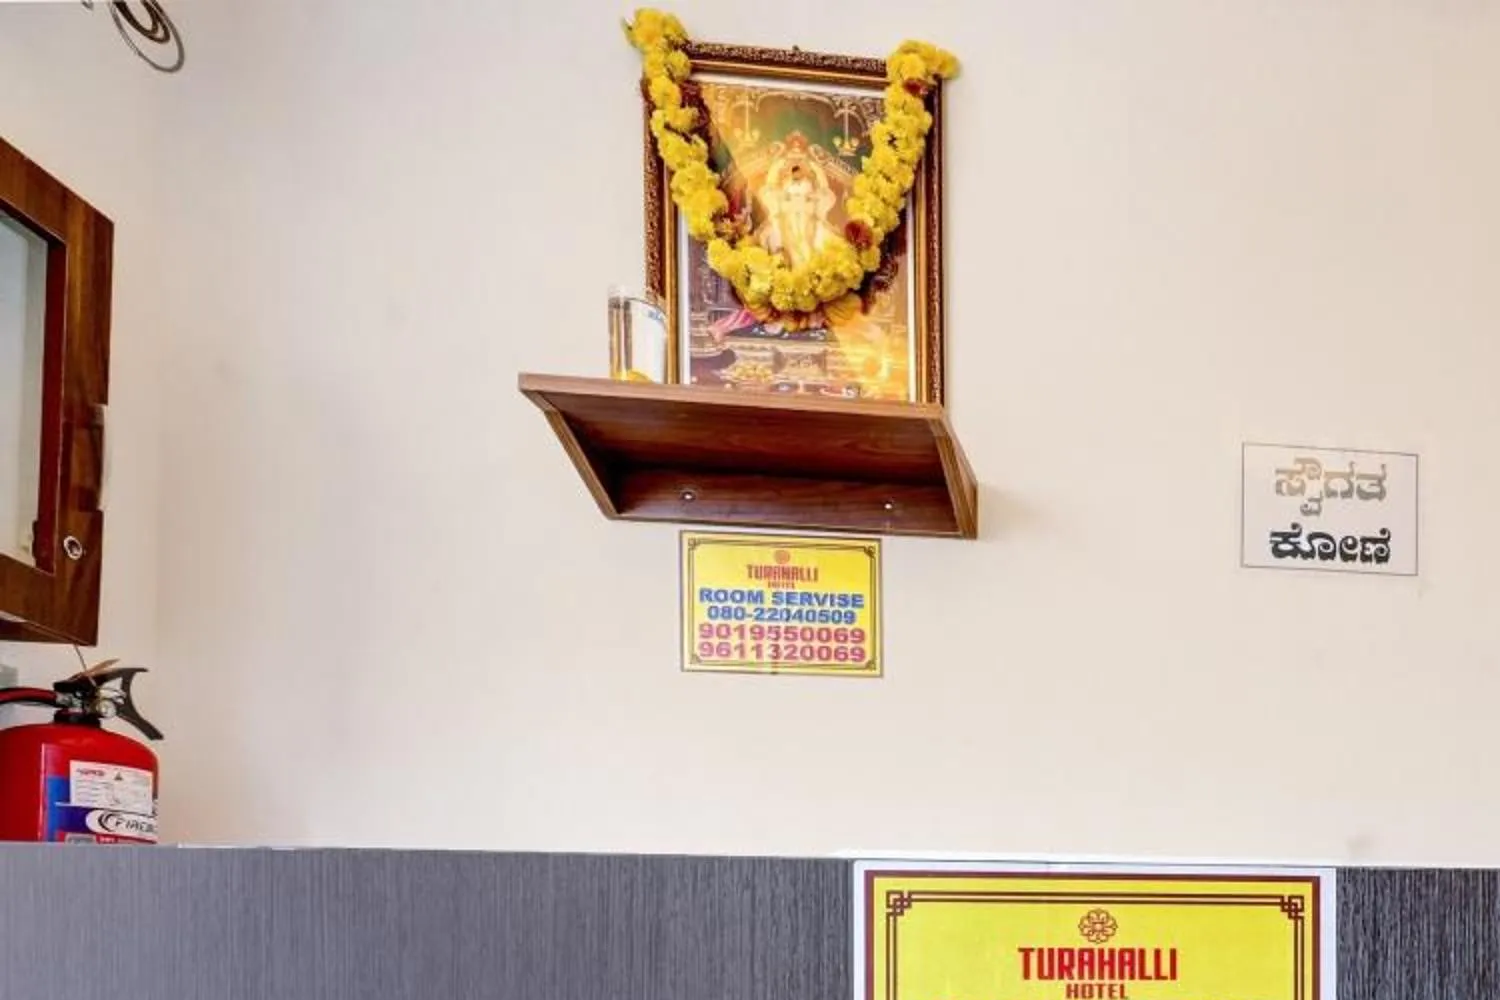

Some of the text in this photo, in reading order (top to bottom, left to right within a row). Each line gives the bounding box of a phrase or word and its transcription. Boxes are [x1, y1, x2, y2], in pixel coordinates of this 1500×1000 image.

[1269, 522, 1392, 564] ಕೋಣೆ
[699, 588, 865, 608] ROOM SERVISE
[707, 606, 856, 625] 080-22040509
[698, 623, 867, 645] 9019550069
[698, 641, 866, 663] 9611320069
[1018, 947, 1178, 981] TURAHALLI
[1066, 984, 1128, 1000] HOTEL
